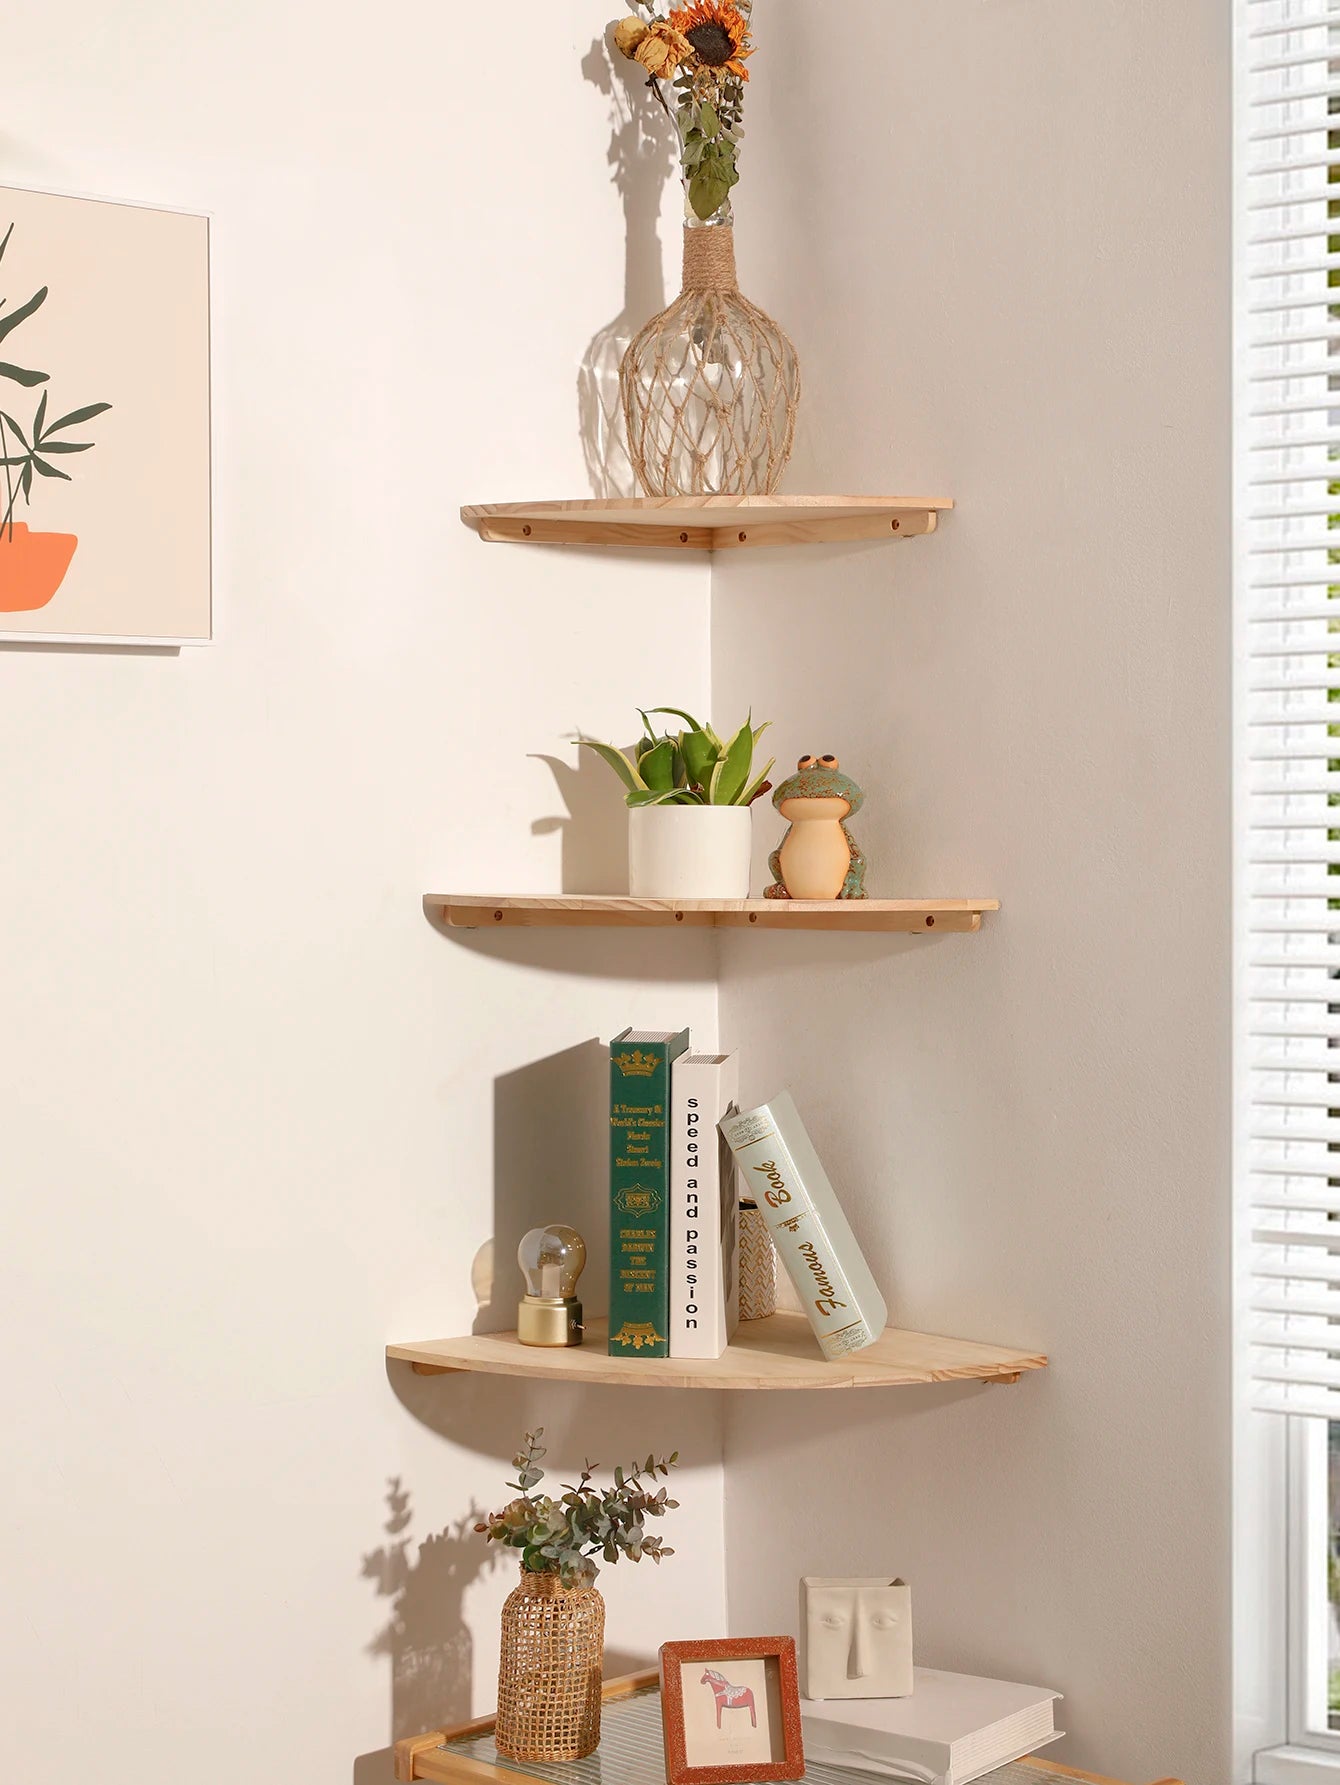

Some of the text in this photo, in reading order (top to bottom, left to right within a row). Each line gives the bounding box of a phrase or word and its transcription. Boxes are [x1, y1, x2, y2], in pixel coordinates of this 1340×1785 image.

[685, 1098, 700, 1329] speed and passion
[620, 1229, 656, 1239] CHARLES
[752, 1160, 847, 1317] Famous Book
[621, 1242, 655, 1252] DARWIN
[629, 1256, 647, 1266] THE
